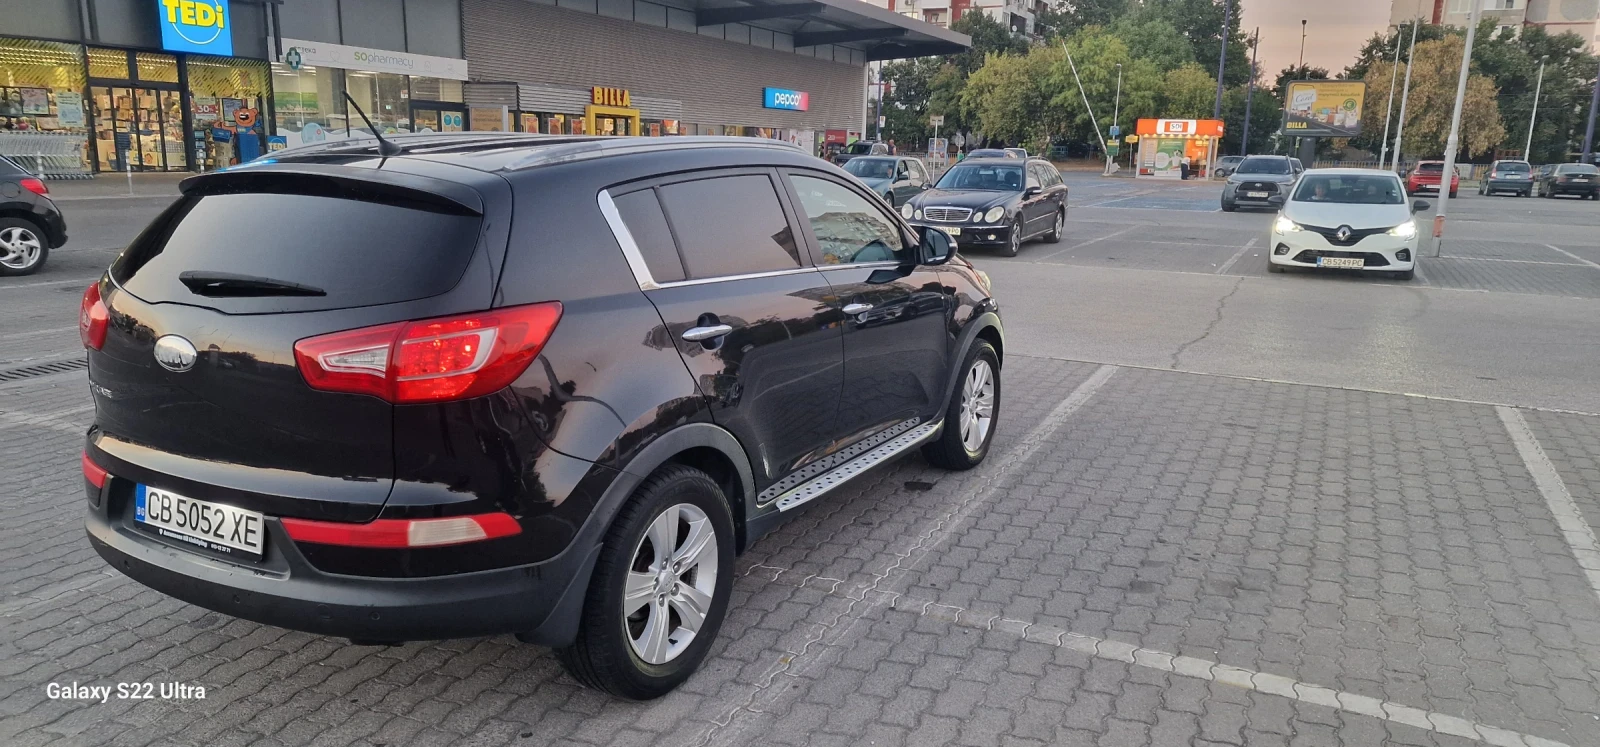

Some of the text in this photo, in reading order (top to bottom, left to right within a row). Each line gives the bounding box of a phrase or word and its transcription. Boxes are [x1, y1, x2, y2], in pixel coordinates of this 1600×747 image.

[162, 0, 224, 29] TEDi
[592, 86, 631, 107] BILLA
[774, 92, 801, 107] pepco
[1286, 121, 1307, 129] BILLA
[1322, 258, 1363, 267] CB 5249 PC
[136, 506, 145, 516] BG
[148, 491, 172, 523] CB
[176, 498, 225, 539] 5052
[230, 511, 258, 548] XE
